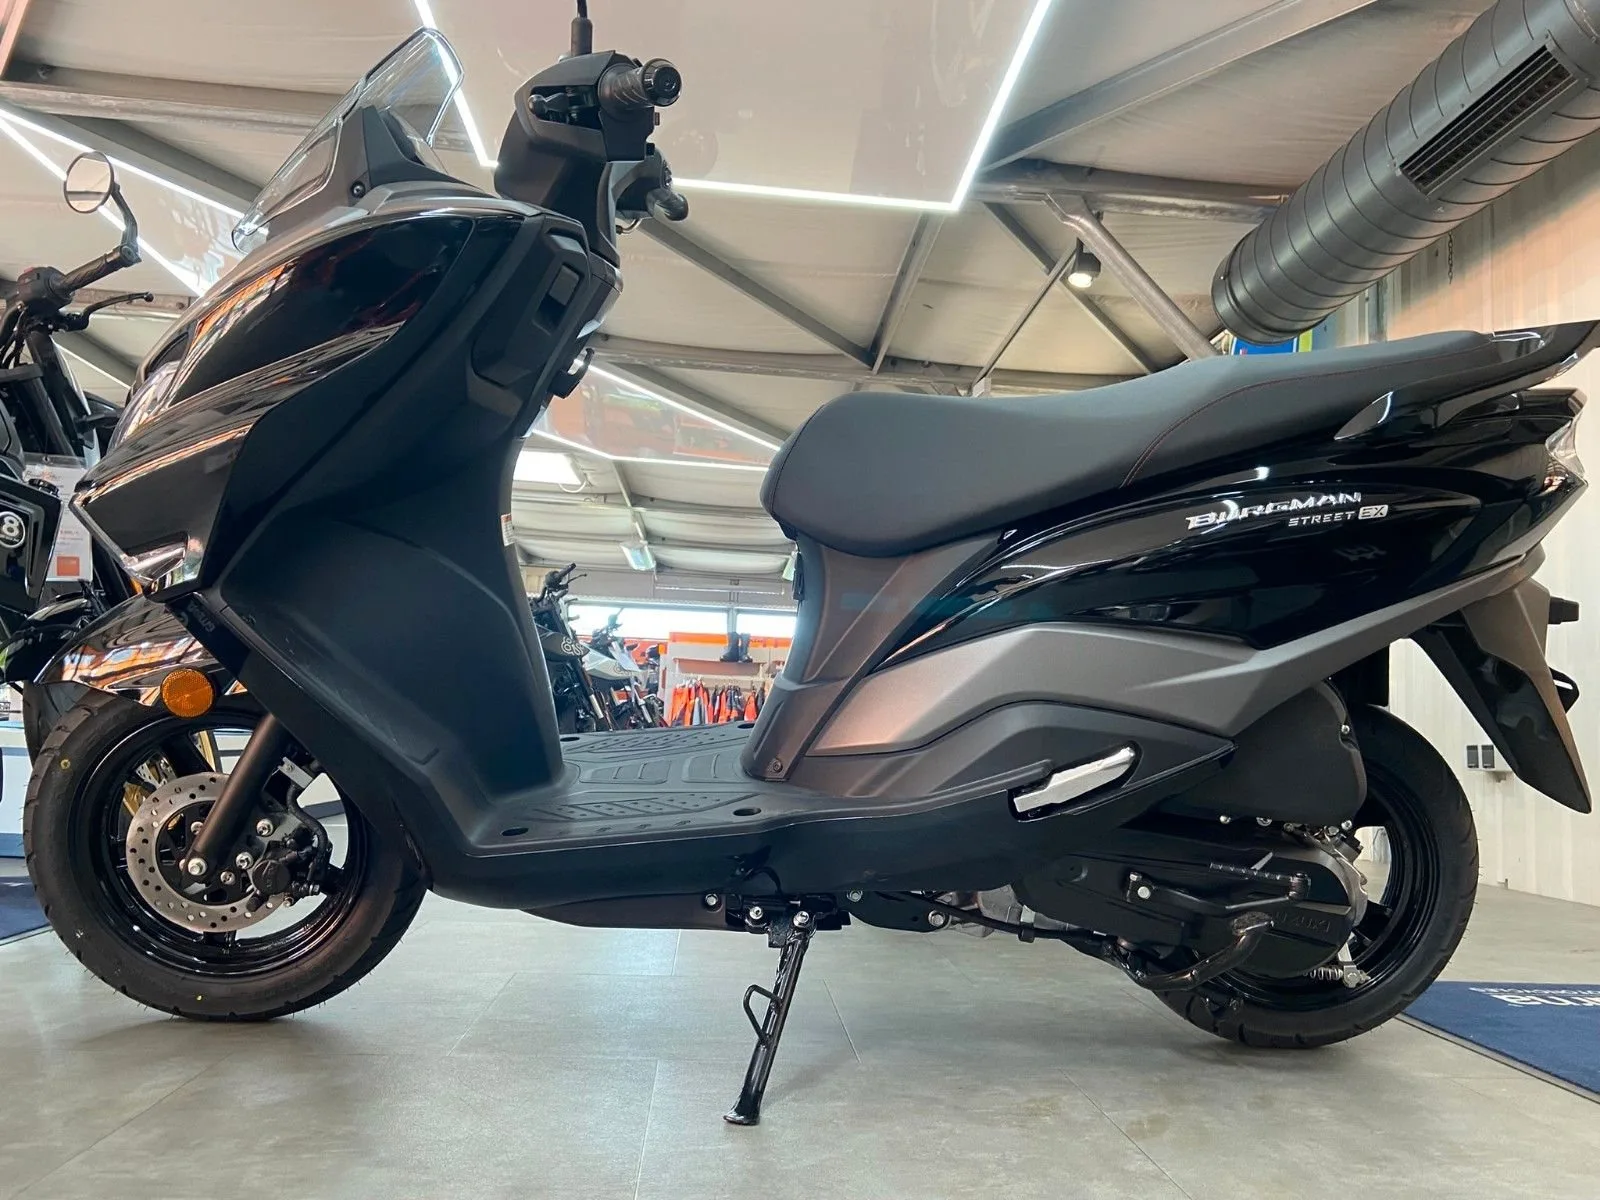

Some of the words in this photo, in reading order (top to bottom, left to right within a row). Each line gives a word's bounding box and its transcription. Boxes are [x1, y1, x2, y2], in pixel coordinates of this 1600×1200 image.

[1186, 492, 1362, 530] BURGMAN
[1288, 511, 1356, 527] STREET
[1359, 505, 1388, 519] EX
